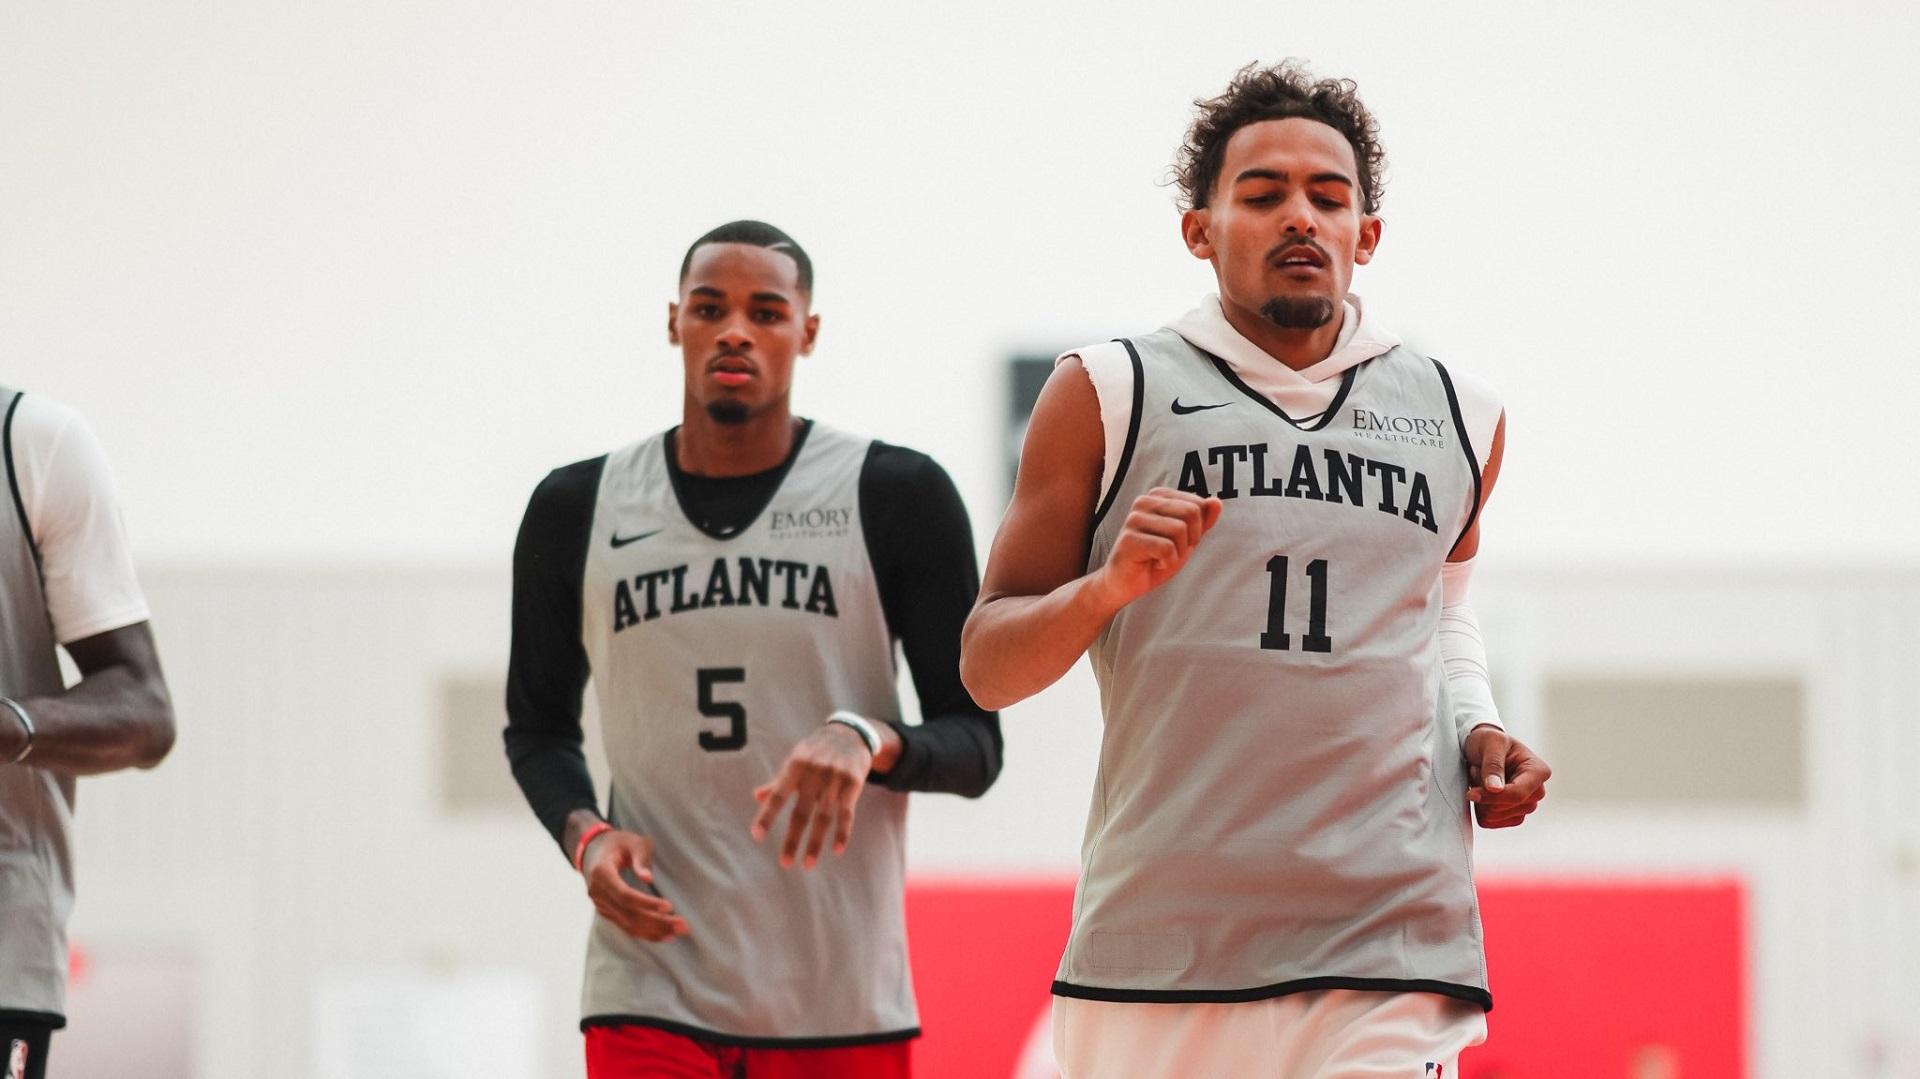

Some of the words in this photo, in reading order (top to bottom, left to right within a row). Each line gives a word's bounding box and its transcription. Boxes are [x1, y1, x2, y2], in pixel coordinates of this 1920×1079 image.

[1352, 408, 1445, 437] EMORY
[1354, 431, 1445, 449] HEALTHCARE
[769, 507, 853, 530] EMORY
[1177, 443, 1439, 534] ATLANTA
[614, 557, 838, 633] ATLANTA
[1260, 555, 1332, 654] 11
[696, 667, 748, 752] 5
